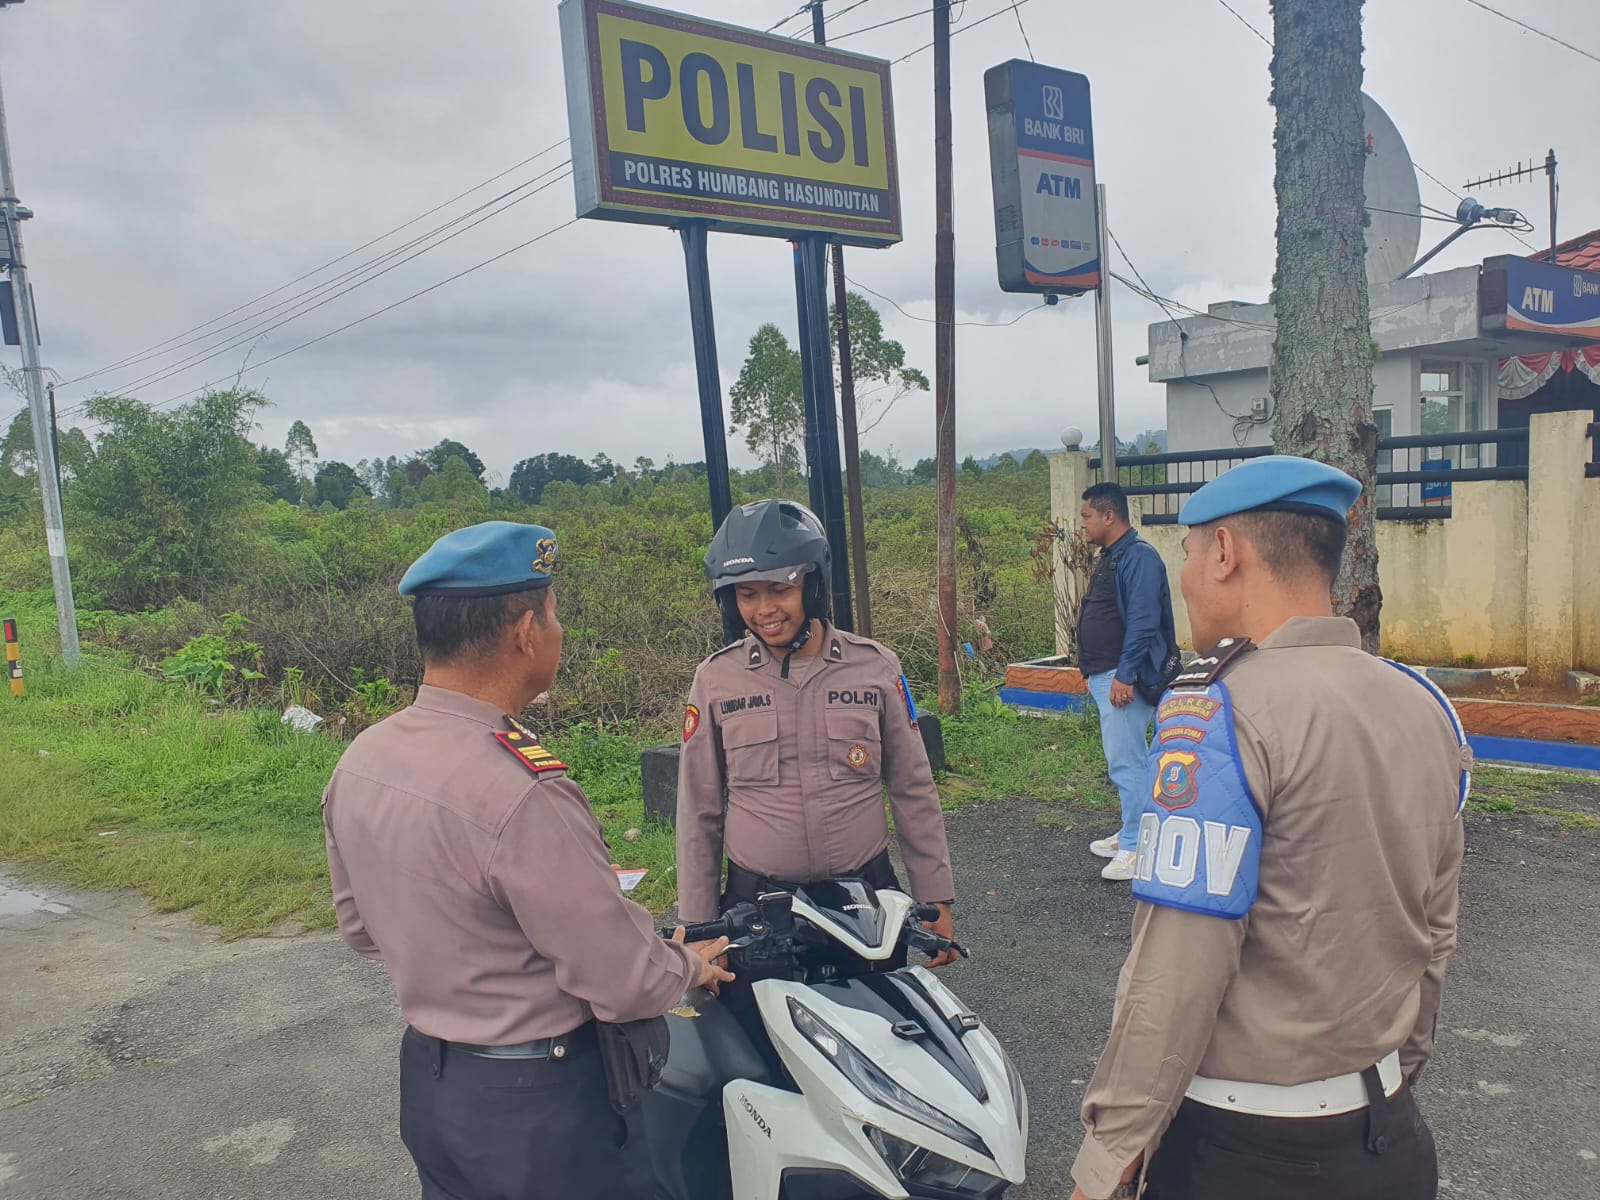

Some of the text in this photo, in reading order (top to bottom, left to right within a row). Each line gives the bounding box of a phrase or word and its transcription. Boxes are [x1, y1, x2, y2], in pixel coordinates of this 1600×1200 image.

[620, 38, 869, 167] POLISI
[1024, 118, 1084, 144] BANK BRI
[624, 160, 880, 212] POLRES HUMBANG HASUNDUTAN
[1036, 173, 1081, 199] ATM
[1521, 286, 1553, 313] ATM
[828, 690, 878, 706] POLRI
[738, 1093, 772, 1140] HONDA
